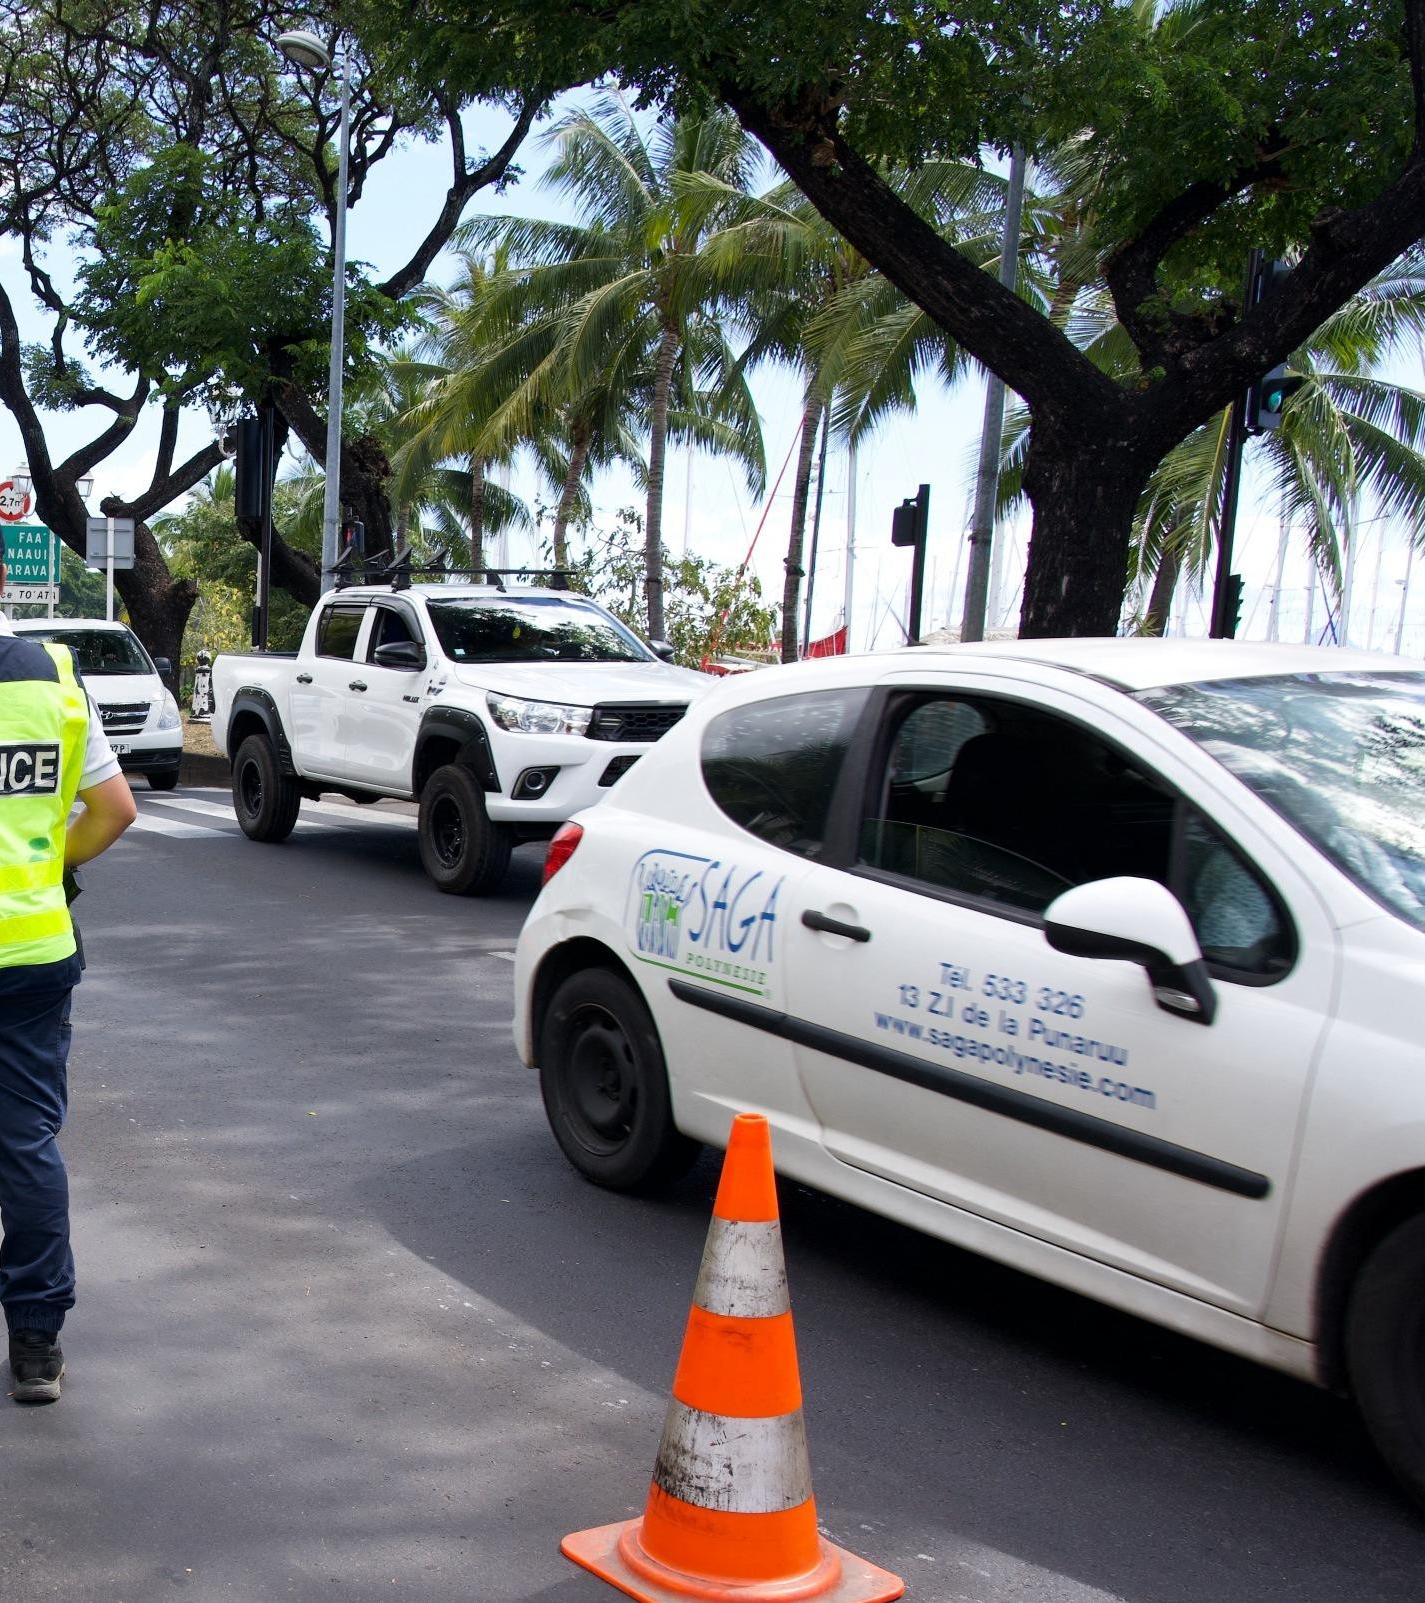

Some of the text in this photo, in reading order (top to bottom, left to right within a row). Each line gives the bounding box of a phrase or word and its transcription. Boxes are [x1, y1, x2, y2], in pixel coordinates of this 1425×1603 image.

[8, 548, 55, 560] NAAUI
[19, 532, 55, 544] FAA'
[6, 564, 55, 576] ARAVA
[689, 861, 787, 963] SAGA
[686, 952, 767, 985] POLYNESIE
[981, 973, 1027, 1005] 533
[1036, 986, 1085, 1019] 326
[897, 983, 920, 1008] 13
[961, 1002, 989, 1028] de
[999, 1009, 1018, 1037] la
[1028, 1017, 1128, 1066] Punaruu
[875, 1011, 1156, 1110] www.sagapolynesie.com
